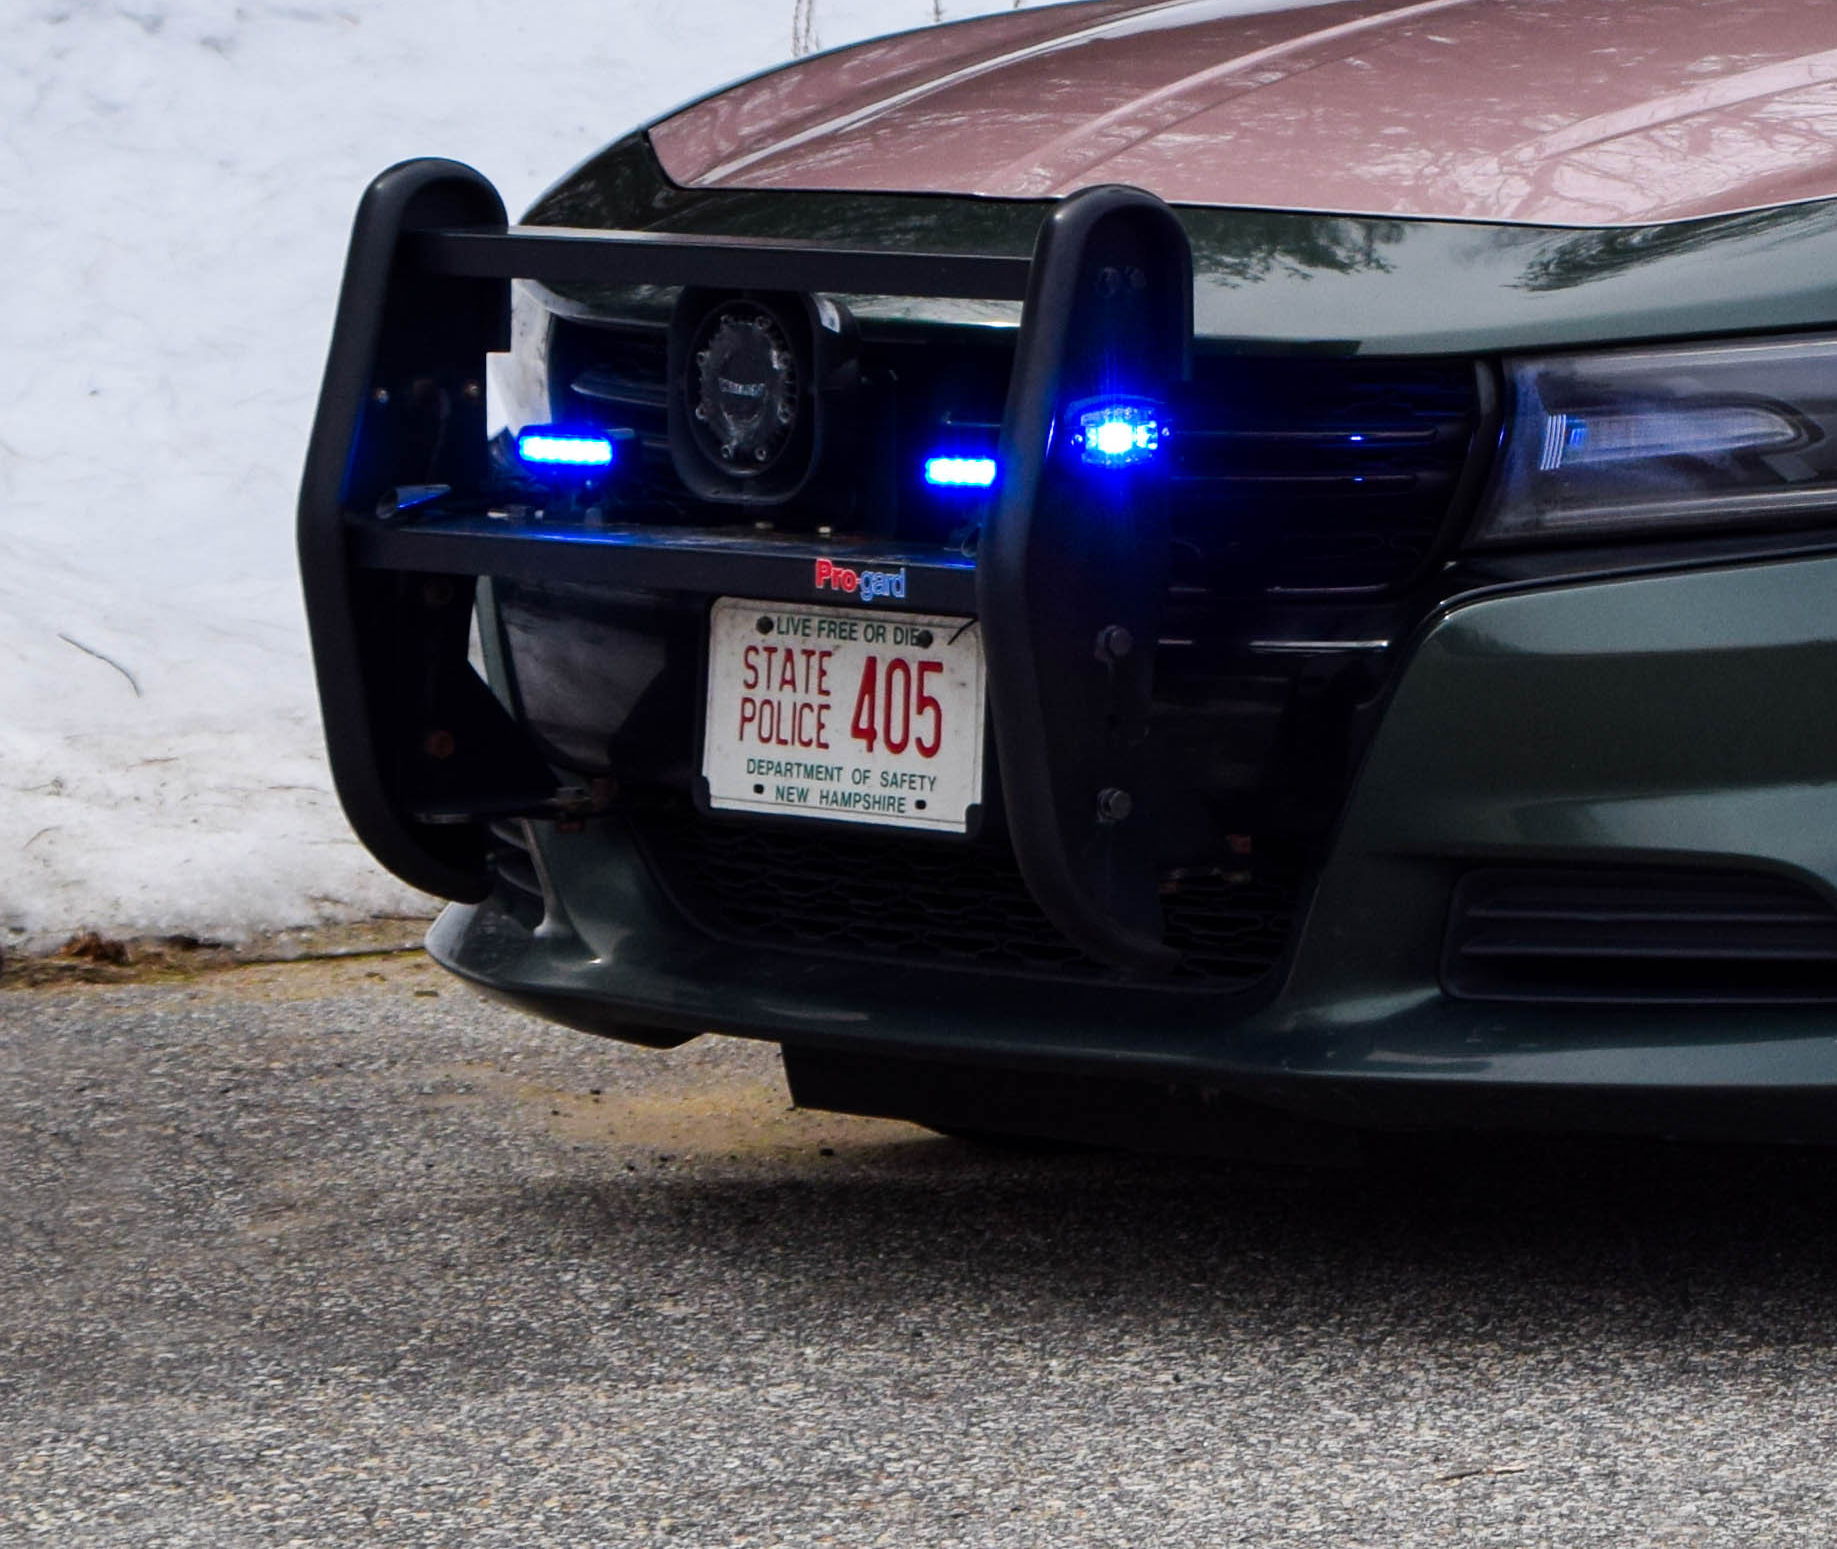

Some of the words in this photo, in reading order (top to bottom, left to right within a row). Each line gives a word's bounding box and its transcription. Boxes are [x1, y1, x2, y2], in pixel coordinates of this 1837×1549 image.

[815, 556, 905, 601] Pro-gard
[776, 616, 811, 637] LIVE
[817, 618, 858, 642] FREE
[863, 623, 887, 644] OR
[893, 626, 920, 646] DIE
[742, 645, 833, 697] STATE
[738, 696, 832, 750] POLICE
[850, 655, 944, 759] 405
[746, 758, 844, 783] DEPARTMENT
[851, 767, 872, 786] OF
[879, 770, 937, 793] SAFETY
[775, 785, 810, 804] NEW
[819, 789, 907, 814] HAMPSHIRE
